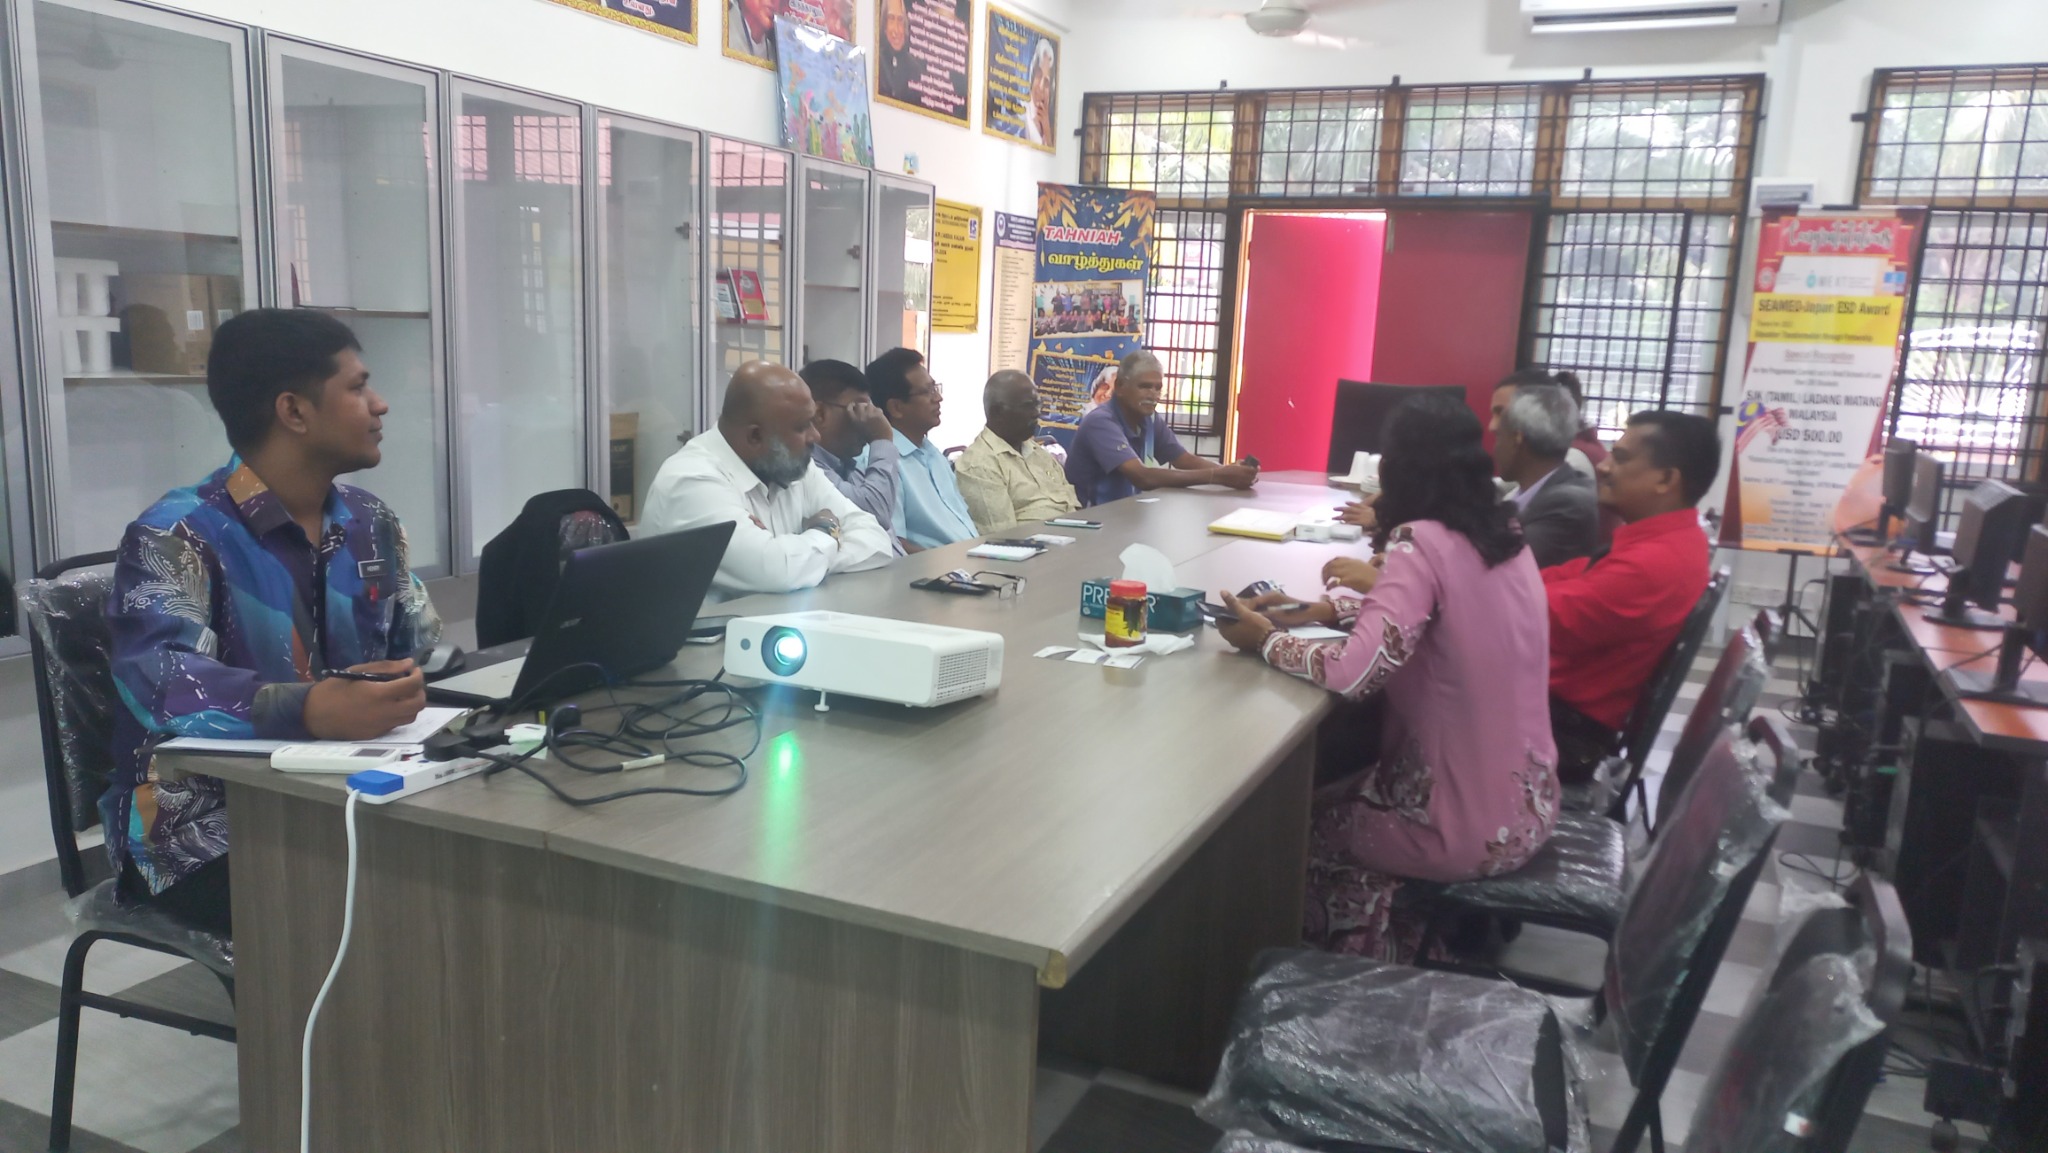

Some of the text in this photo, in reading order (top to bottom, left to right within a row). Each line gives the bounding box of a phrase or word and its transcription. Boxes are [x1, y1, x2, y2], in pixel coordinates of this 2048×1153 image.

[1044, 226, 1121, 246] TAHNIAH
[1048, 251, 1144, 273] வாழ்த்துகள்
[1837, 301, 1857, 314] ESD
[1859, 302, 1892, 316] Award
[1802, 392, 1841, 405] LADANG
[1788, 408, 1838, 421] MALAYSIA
[1803, 428, 1843, 443] 500.00
[1082, 584, 1157, 613] PRER
